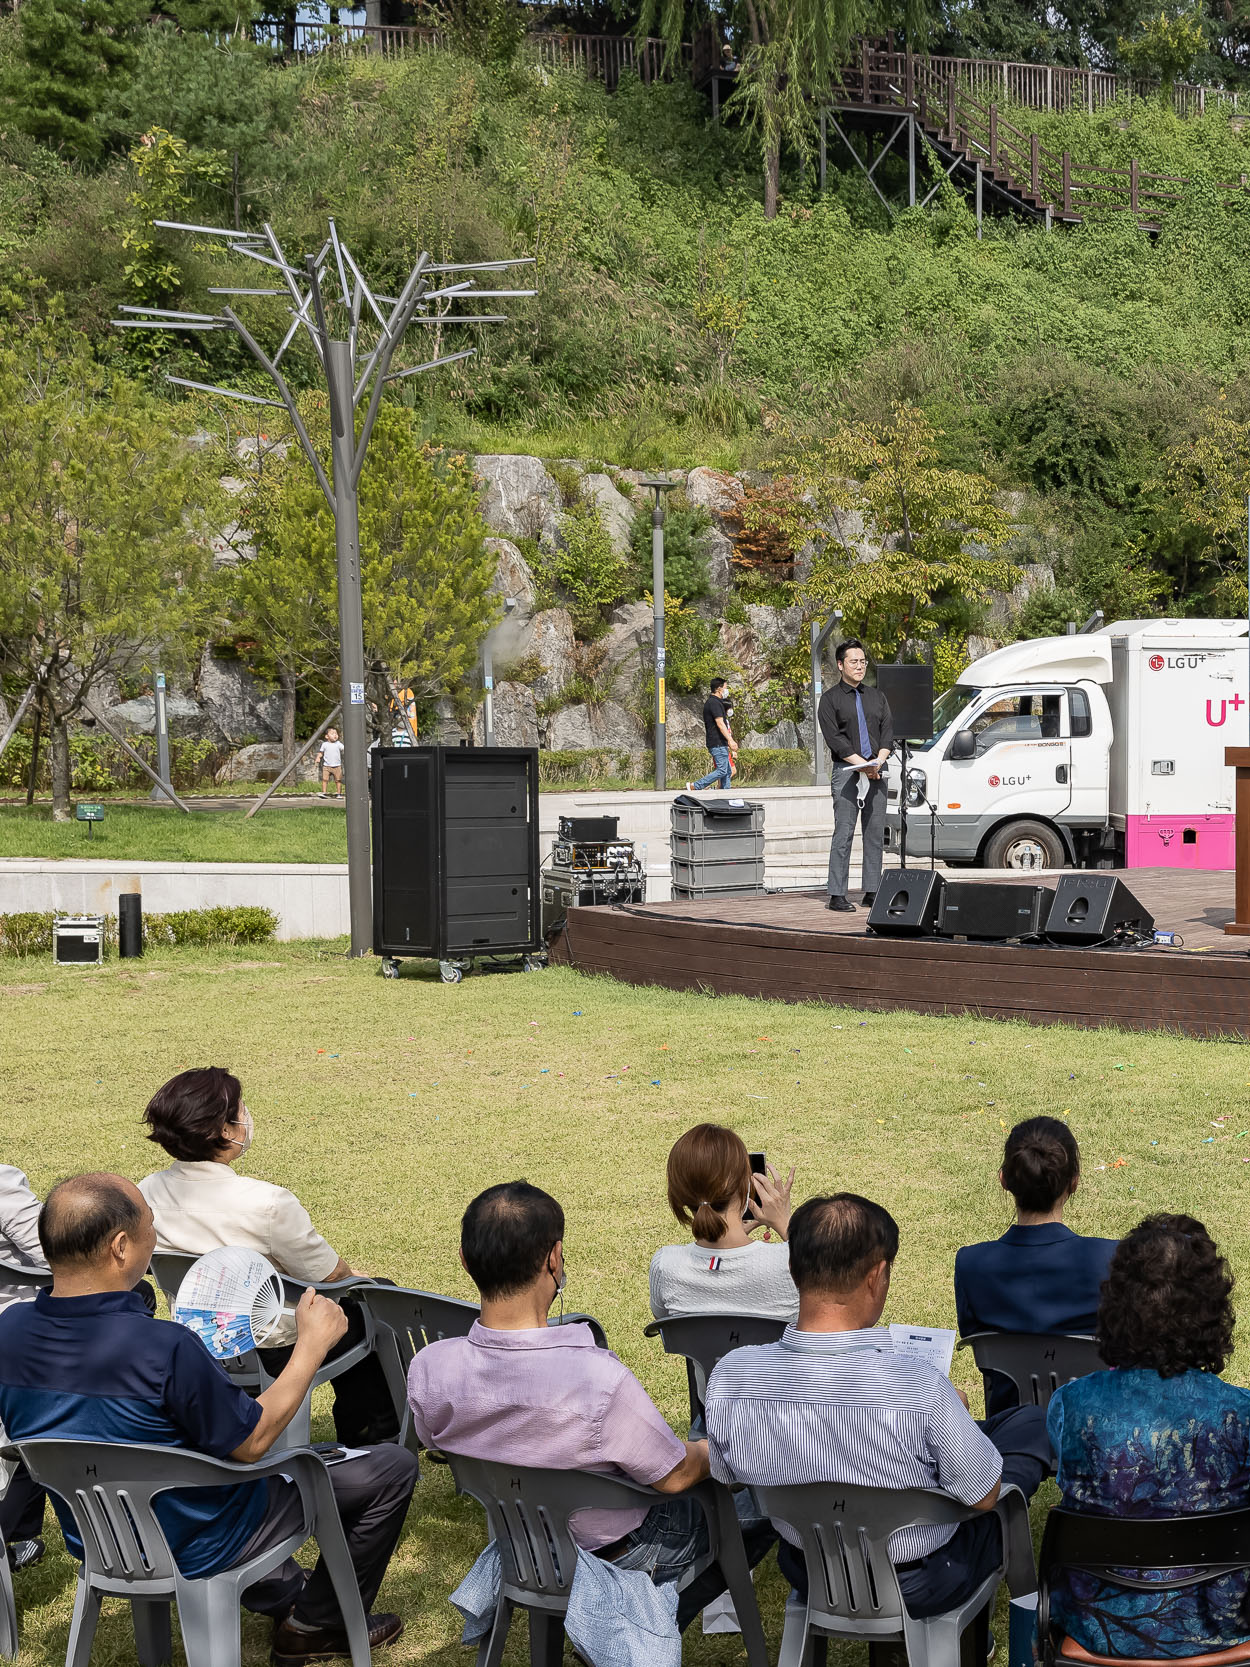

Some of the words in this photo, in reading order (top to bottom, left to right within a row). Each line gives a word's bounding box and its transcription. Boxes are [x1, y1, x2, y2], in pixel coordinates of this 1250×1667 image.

[1206, 693, 1245, 727] U+
[728, 1330, 741, 1344] H
[1044, 1348, 1056, 1361] H
[85, 1463, 98, 1478] H
[510, 1477, 521, 1491] H
[832, 1499, 846, 1513] H
